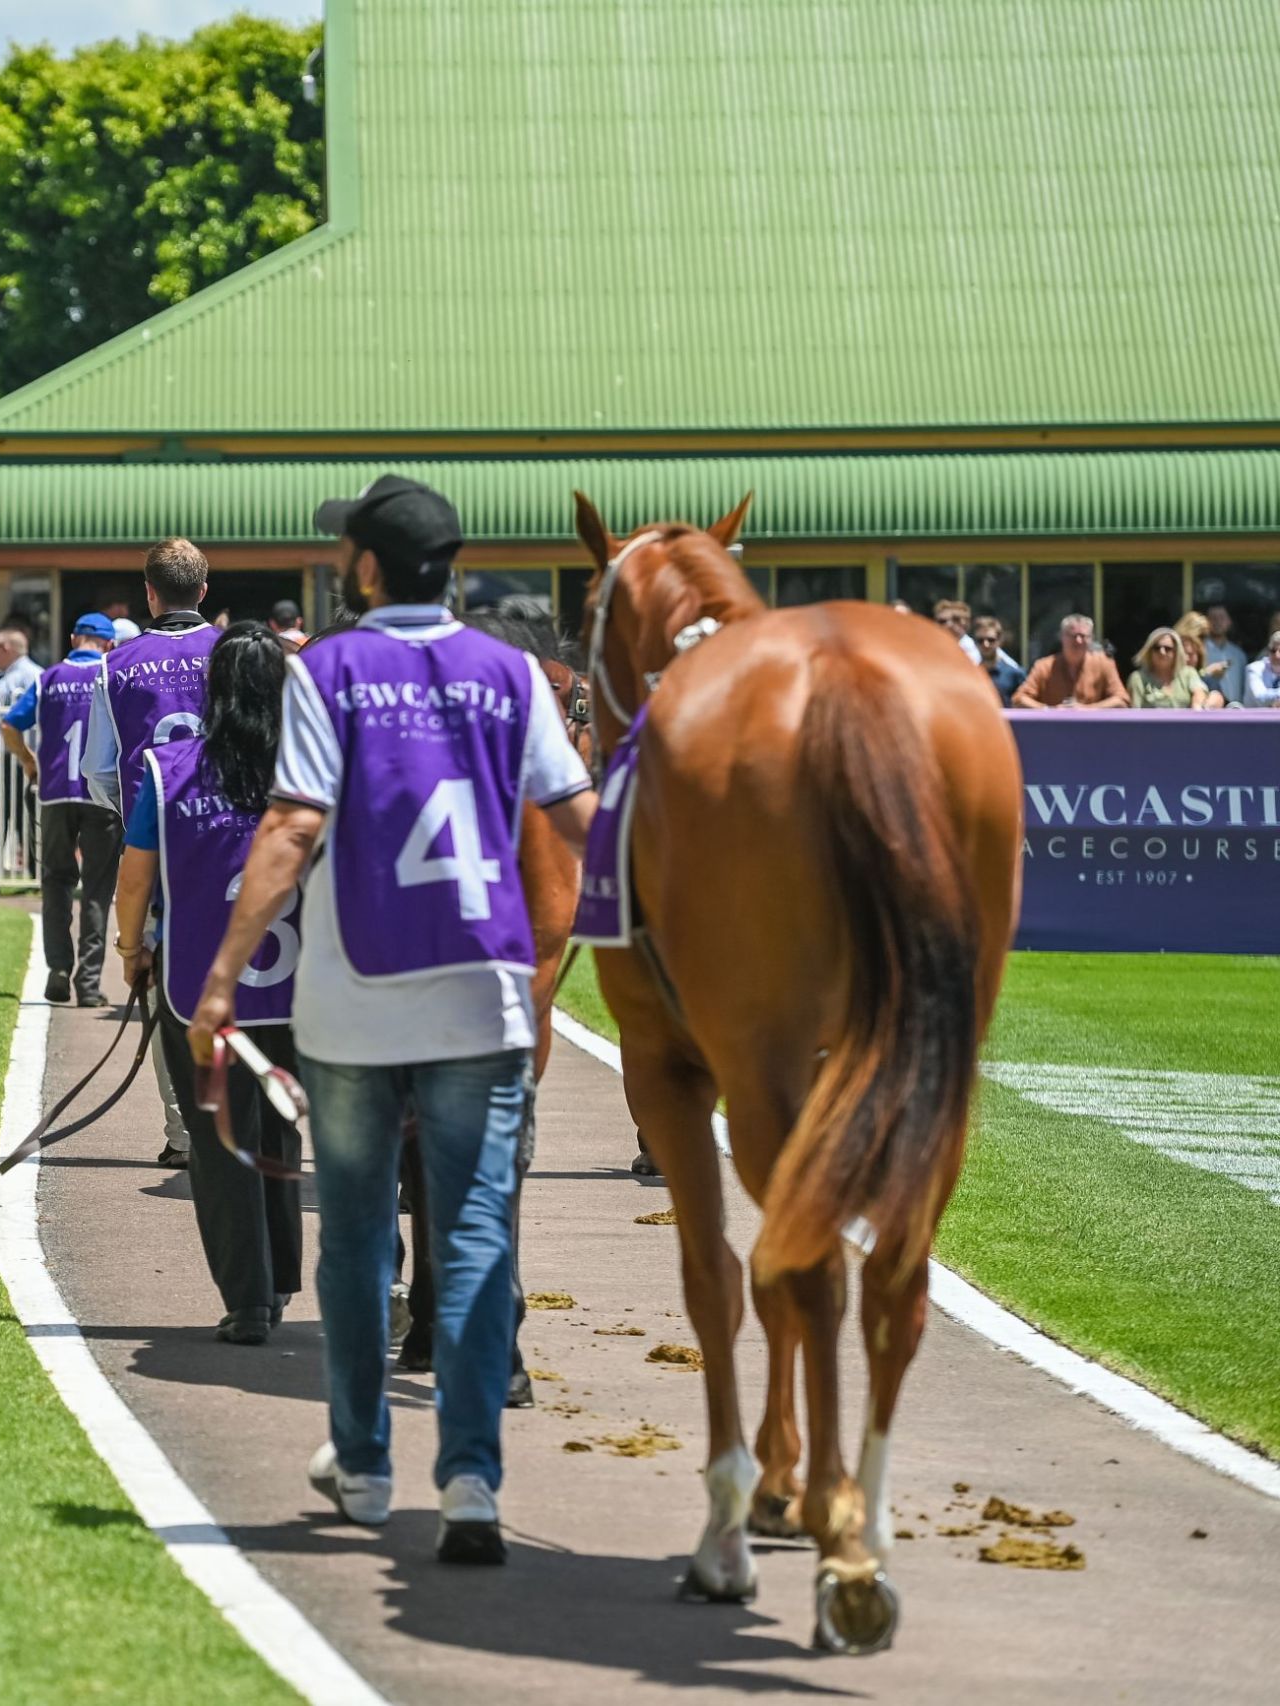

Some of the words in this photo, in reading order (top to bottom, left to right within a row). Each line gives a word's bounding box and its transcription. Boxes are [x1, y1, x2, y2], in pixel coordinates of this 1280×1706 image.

[64, 719, 83, 781] 1
[394, 778, 502, 920] 4
[1096, 870, 1125, 885] EST
[1136, 870, 1178, 885] 1907
